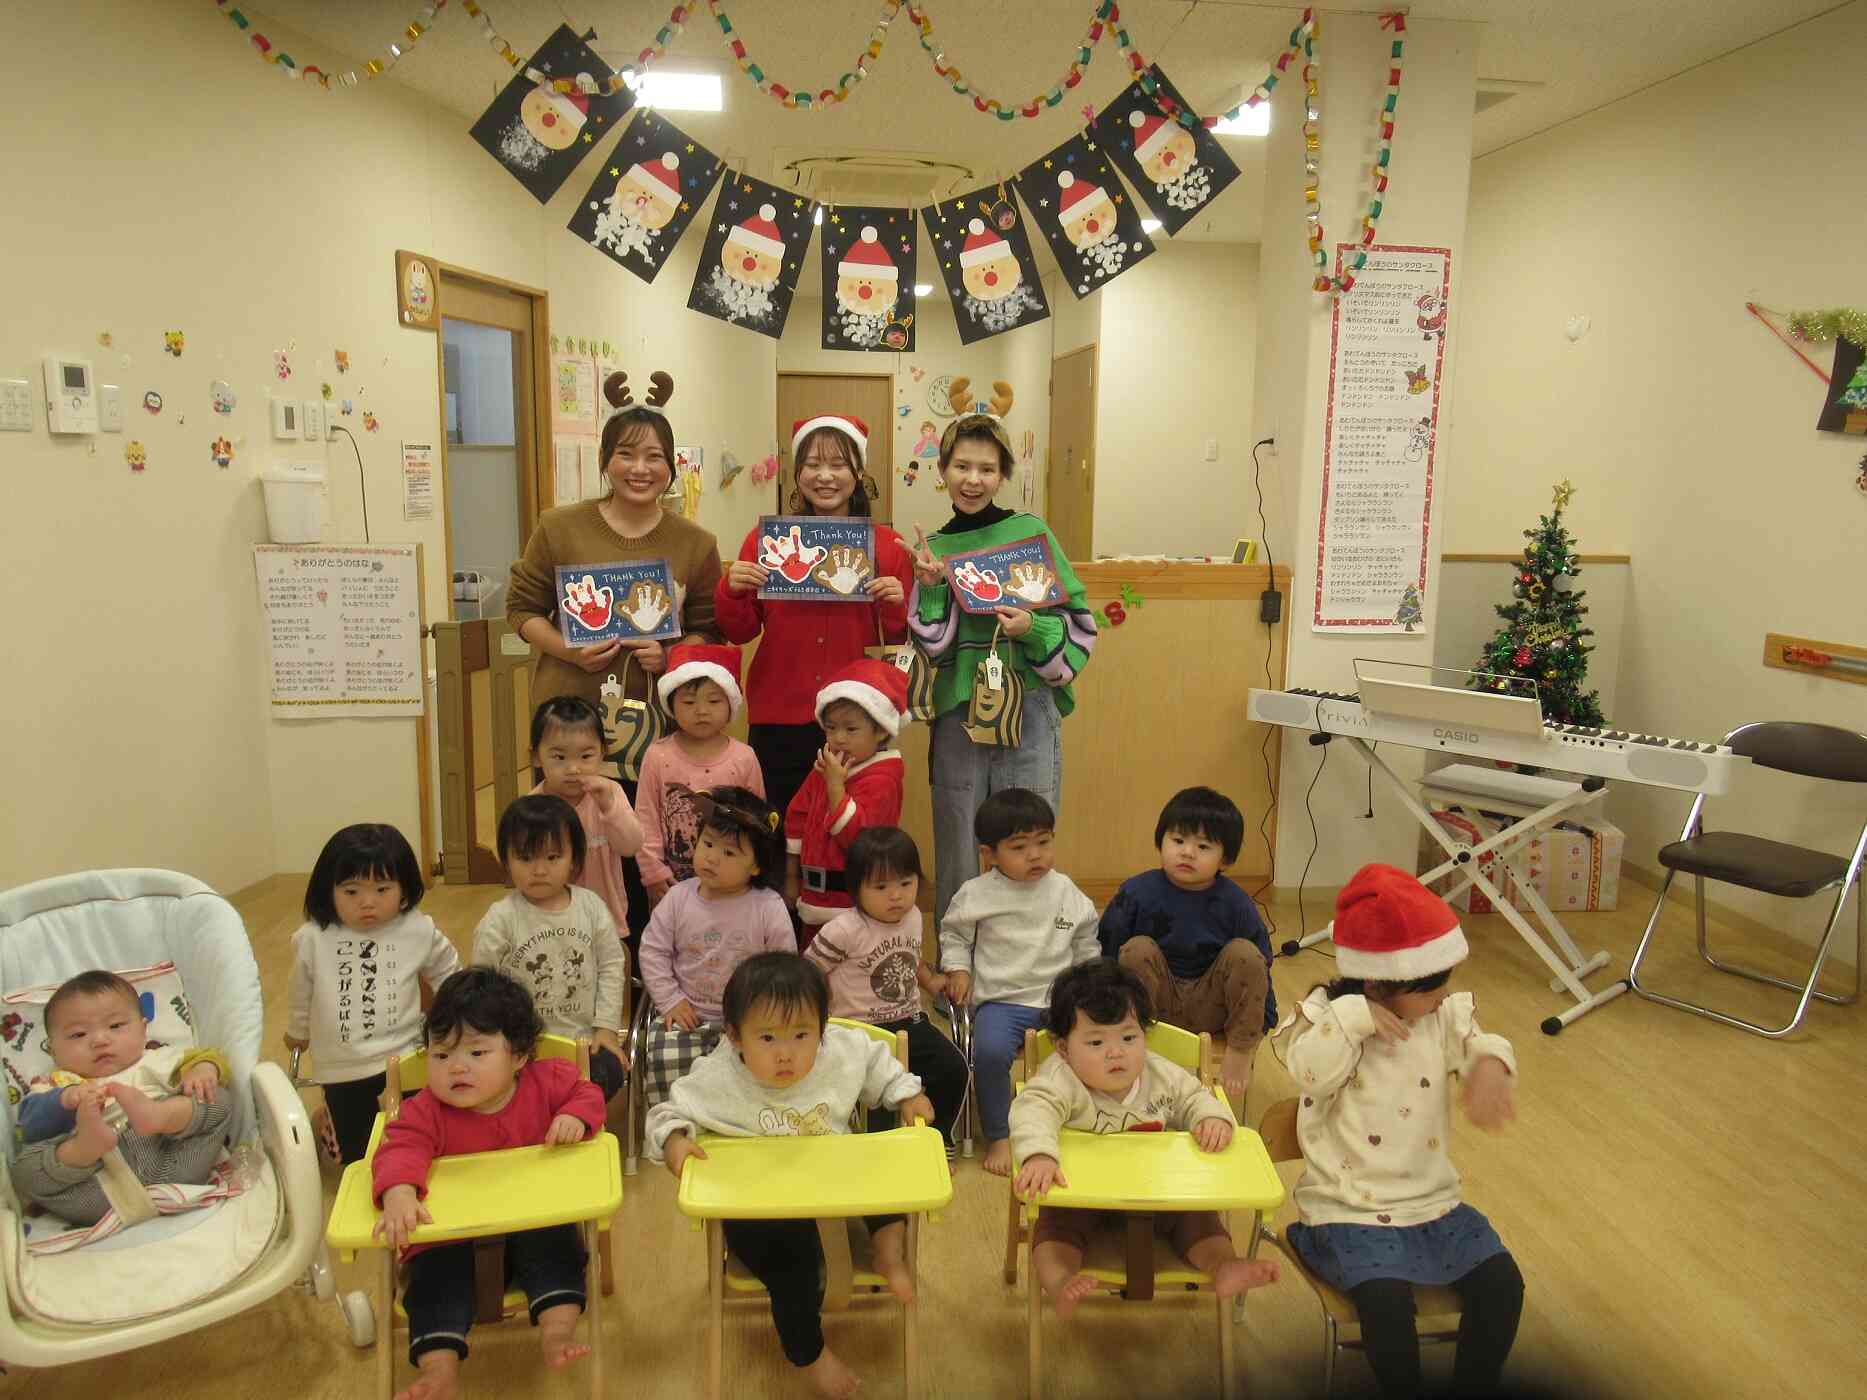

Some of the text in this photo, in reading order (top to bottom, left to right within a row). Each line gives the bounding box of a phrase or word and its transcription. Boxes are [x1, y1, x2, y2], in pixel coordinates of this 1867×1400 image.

[809, 529, 843, 540] Thank
[992, 552, 1020, 563] THANK
[603, 572, 635, 583] THANK
[1433, 728, 1479, 744] CASIO
[511, 927, 565, 969] EVERYTHING
[567, 927, 577, 937] IS
[858, 936, 902, 969] NATURAL
[558, 1002, 581, 1014] YOU
